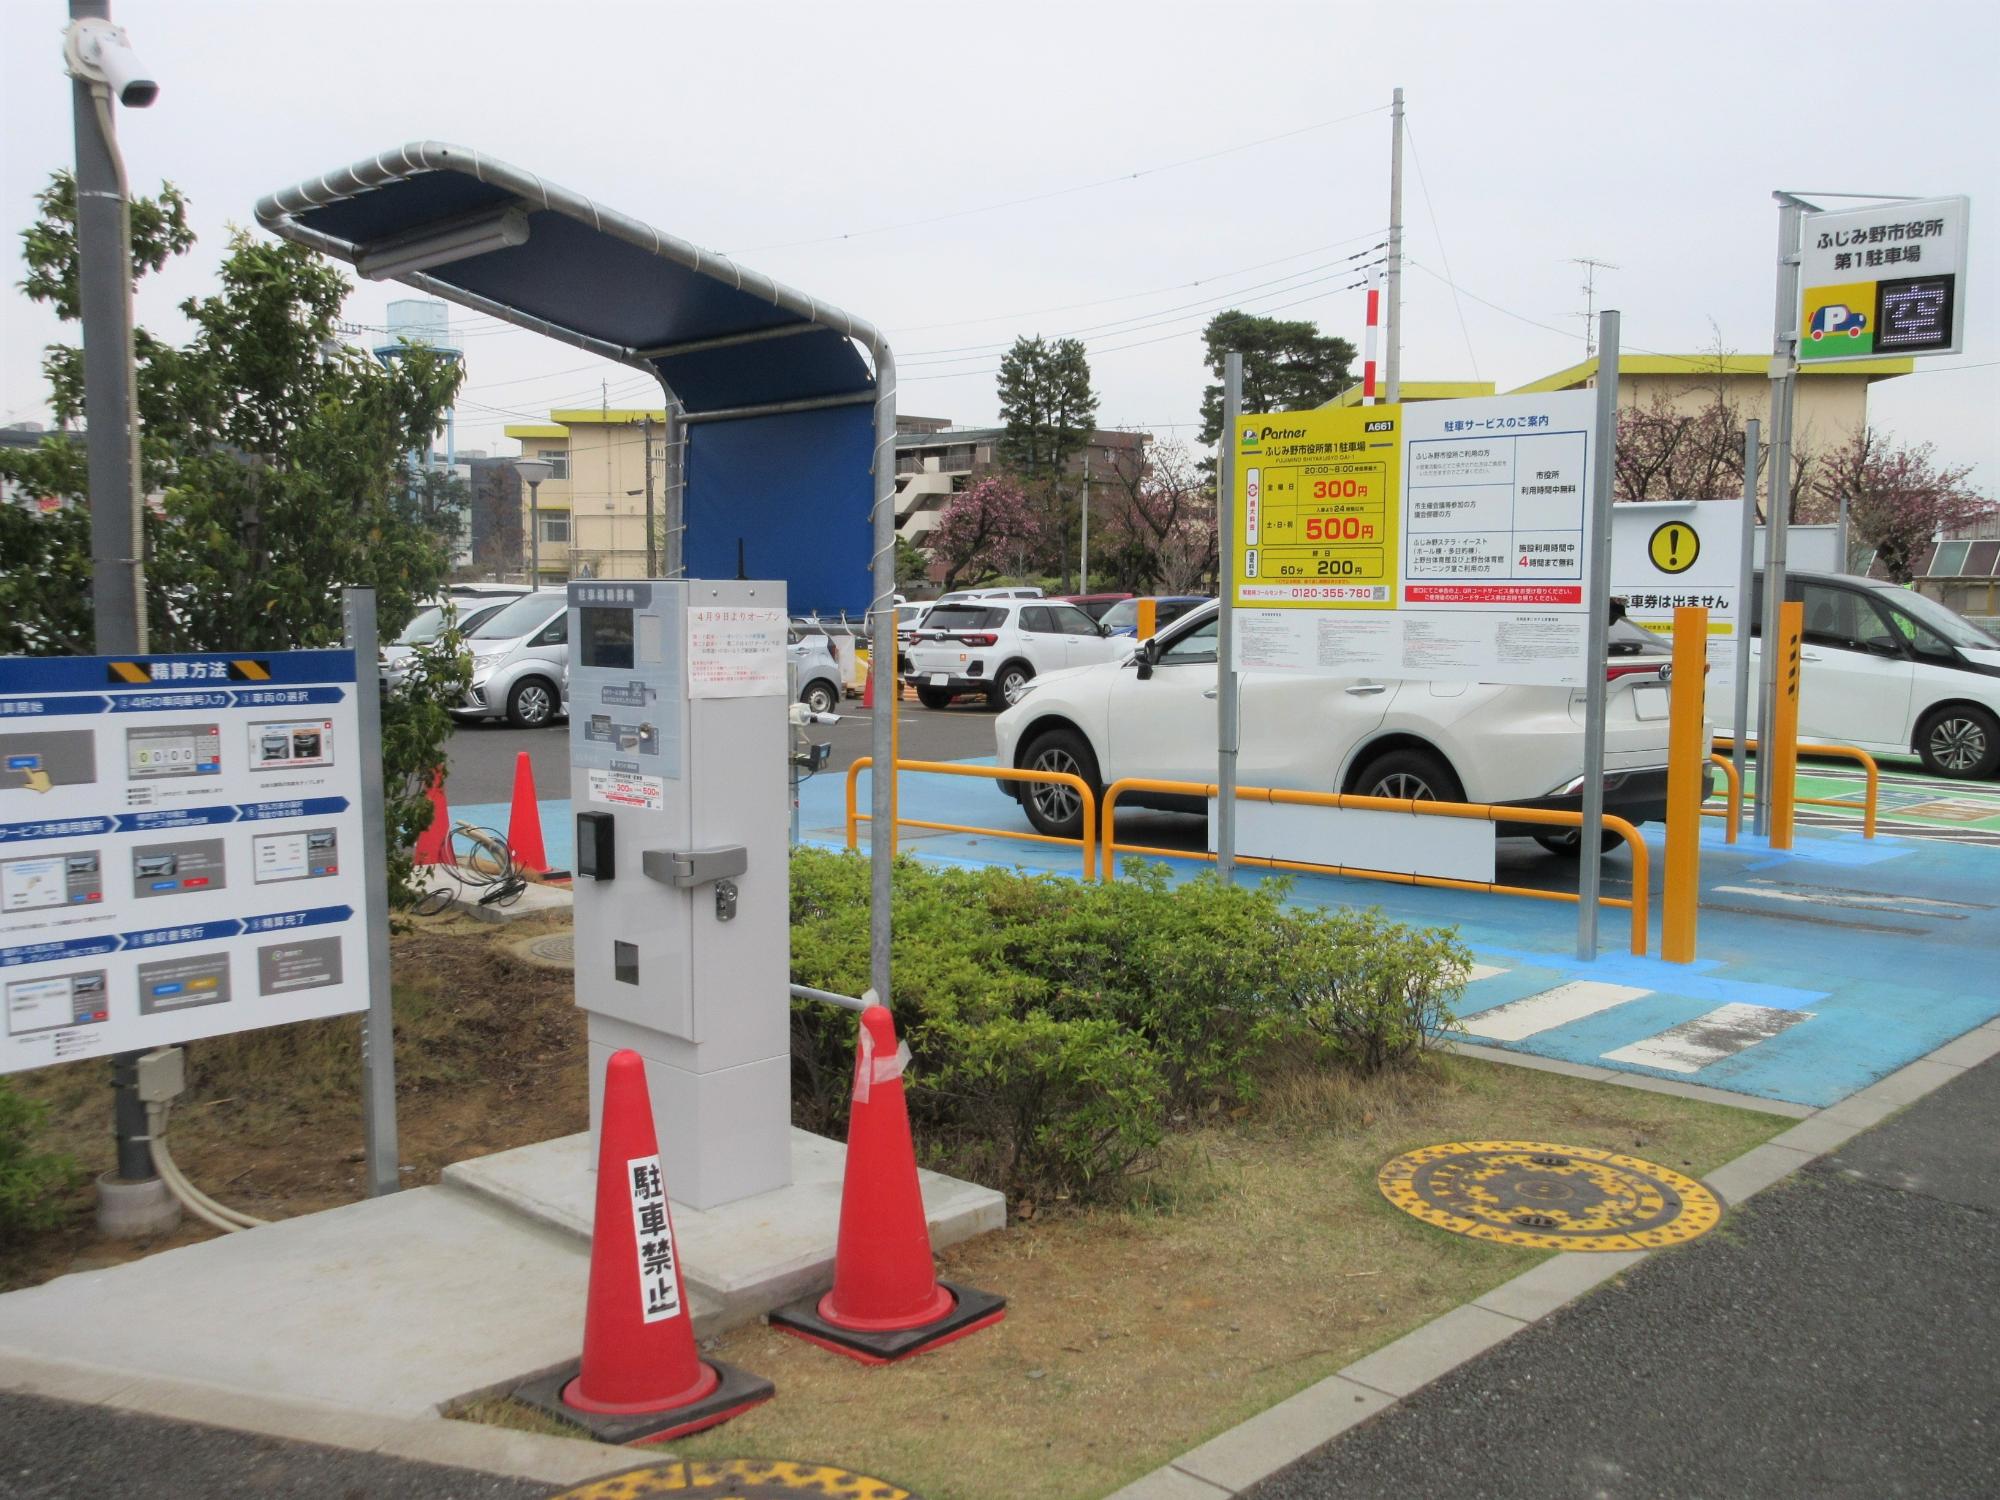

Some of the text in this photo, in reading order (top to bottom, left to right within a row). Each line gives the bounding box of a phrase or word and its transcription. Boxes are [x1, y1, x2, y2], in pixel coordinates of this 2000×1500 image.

[1817, 218, 1944, 249] ふじみ野市役所
[1834, 245, 1921, 271] 第1駐車場
[1883, 285, 1945, 343] 空
[1367, 421, 1392, 432] A661
[1444, 414, 1549, 433] 駐車サービスのご案内
[1261, 426, 1307, 440] Partner
[1265, 440, 1366, 456] ふじみ野市役所第1駐車場
[1416, 449, 1490, 460] ふじみ野市役所ご利用の方
[1536, 470, 1560, 480] 市役所
[1313, 479, 1368, 499] 300円
[1521, 485, 1576, 495] 利用時間中無料
[1306, 517, 1374, 540] 500円
[1518, 544, 1575, 553] 施設利用時間中
[1281, 560, 1362, 575] 60分 200円
[1518, 555, 1574, 568] 4時間まで無料
[1292, 588, 1371, 598] 0120-355-780
[150, 661, 228, 680] 精算方法
[252, 691, 309, 703] 車両の選択
[0, 702, 45, 714] 算開始
[633, 1163, 677, 1315] 駐車禁止
